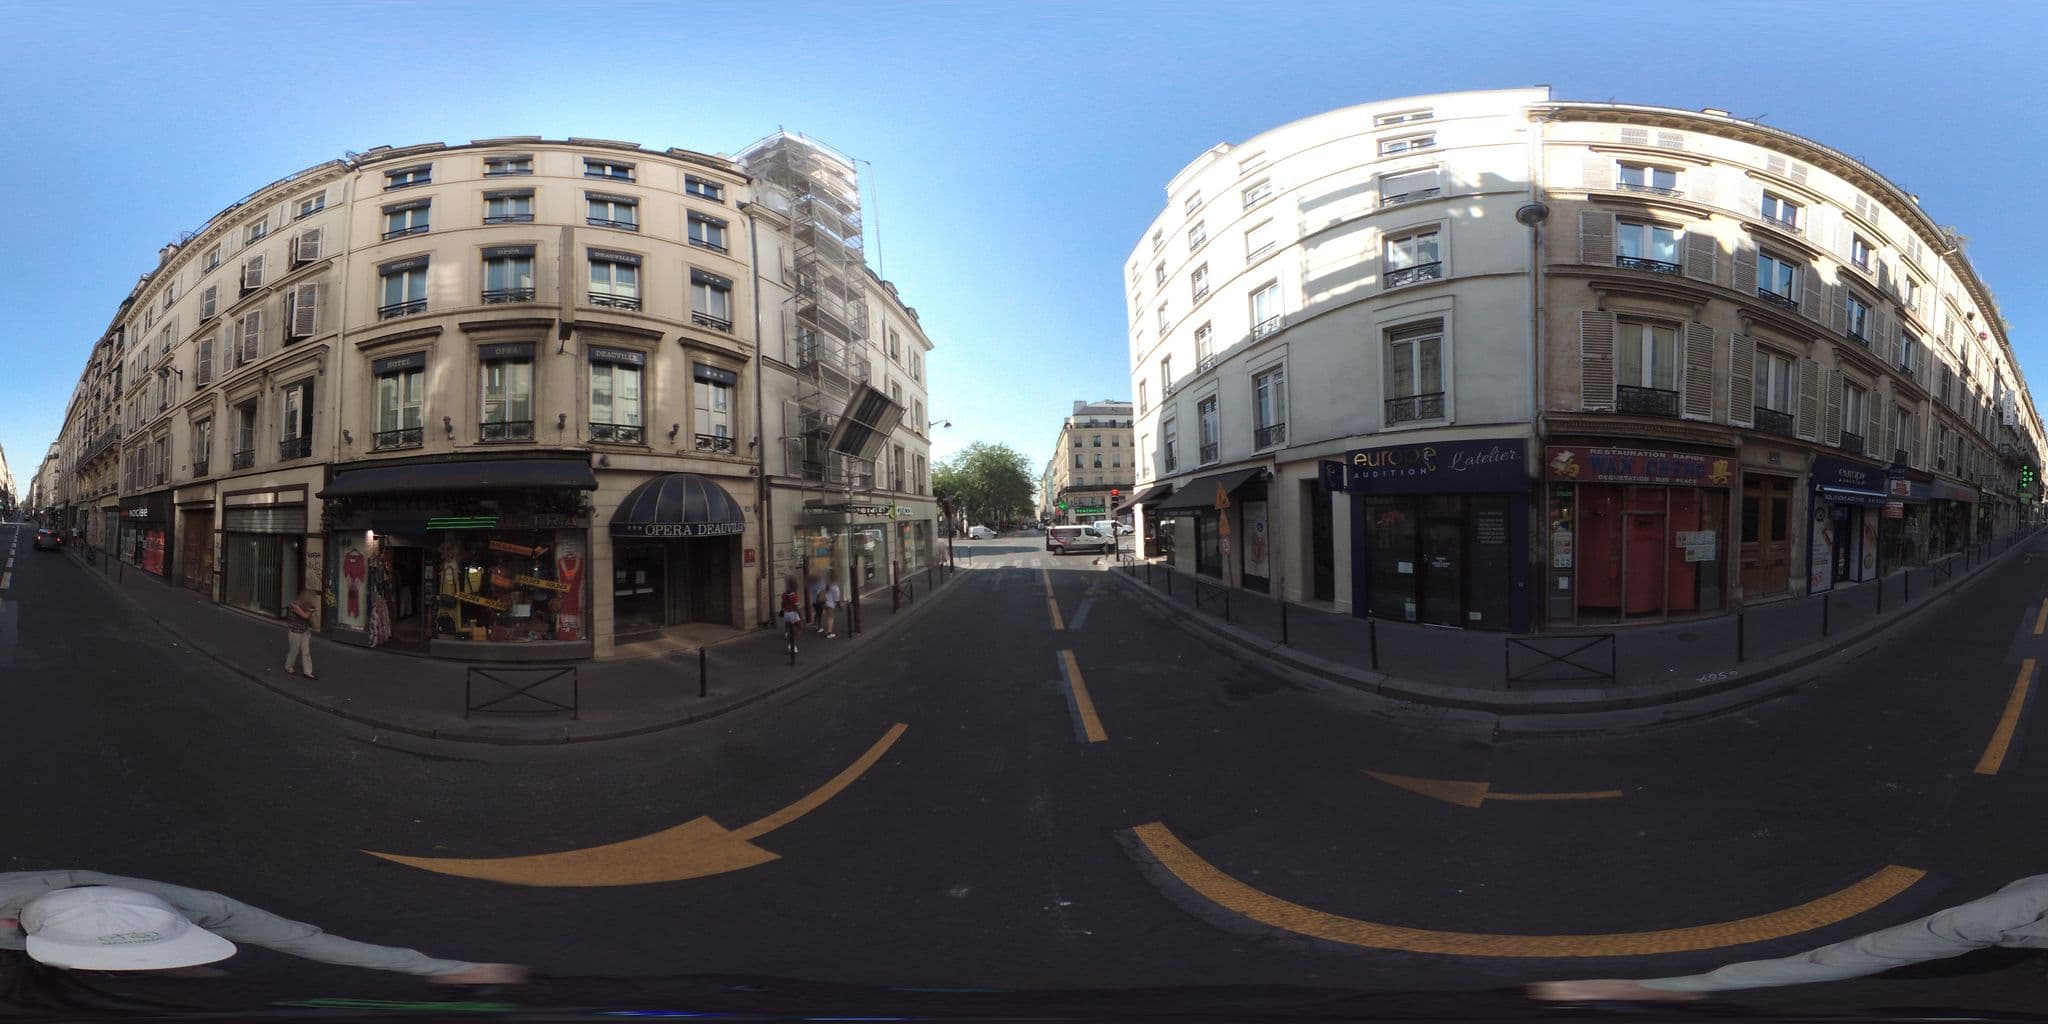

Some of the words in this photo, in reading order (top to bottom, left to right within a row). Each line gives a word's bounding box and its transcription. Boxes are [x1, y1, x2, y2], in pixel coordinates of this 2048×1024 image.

[594, 251, 637, 263] DEAUVILLE
[595, 350, 640, 363] DEAUVILLE
[386, 358, 410, 369] HOTEL
[1589, 448, 1667, 459] RESTAURATION
[1672, 453, 1706, 463] RAPIDE
[1353, 468, 1427, 479] AUDITION
[644, 524, 692, 536] OPERA
